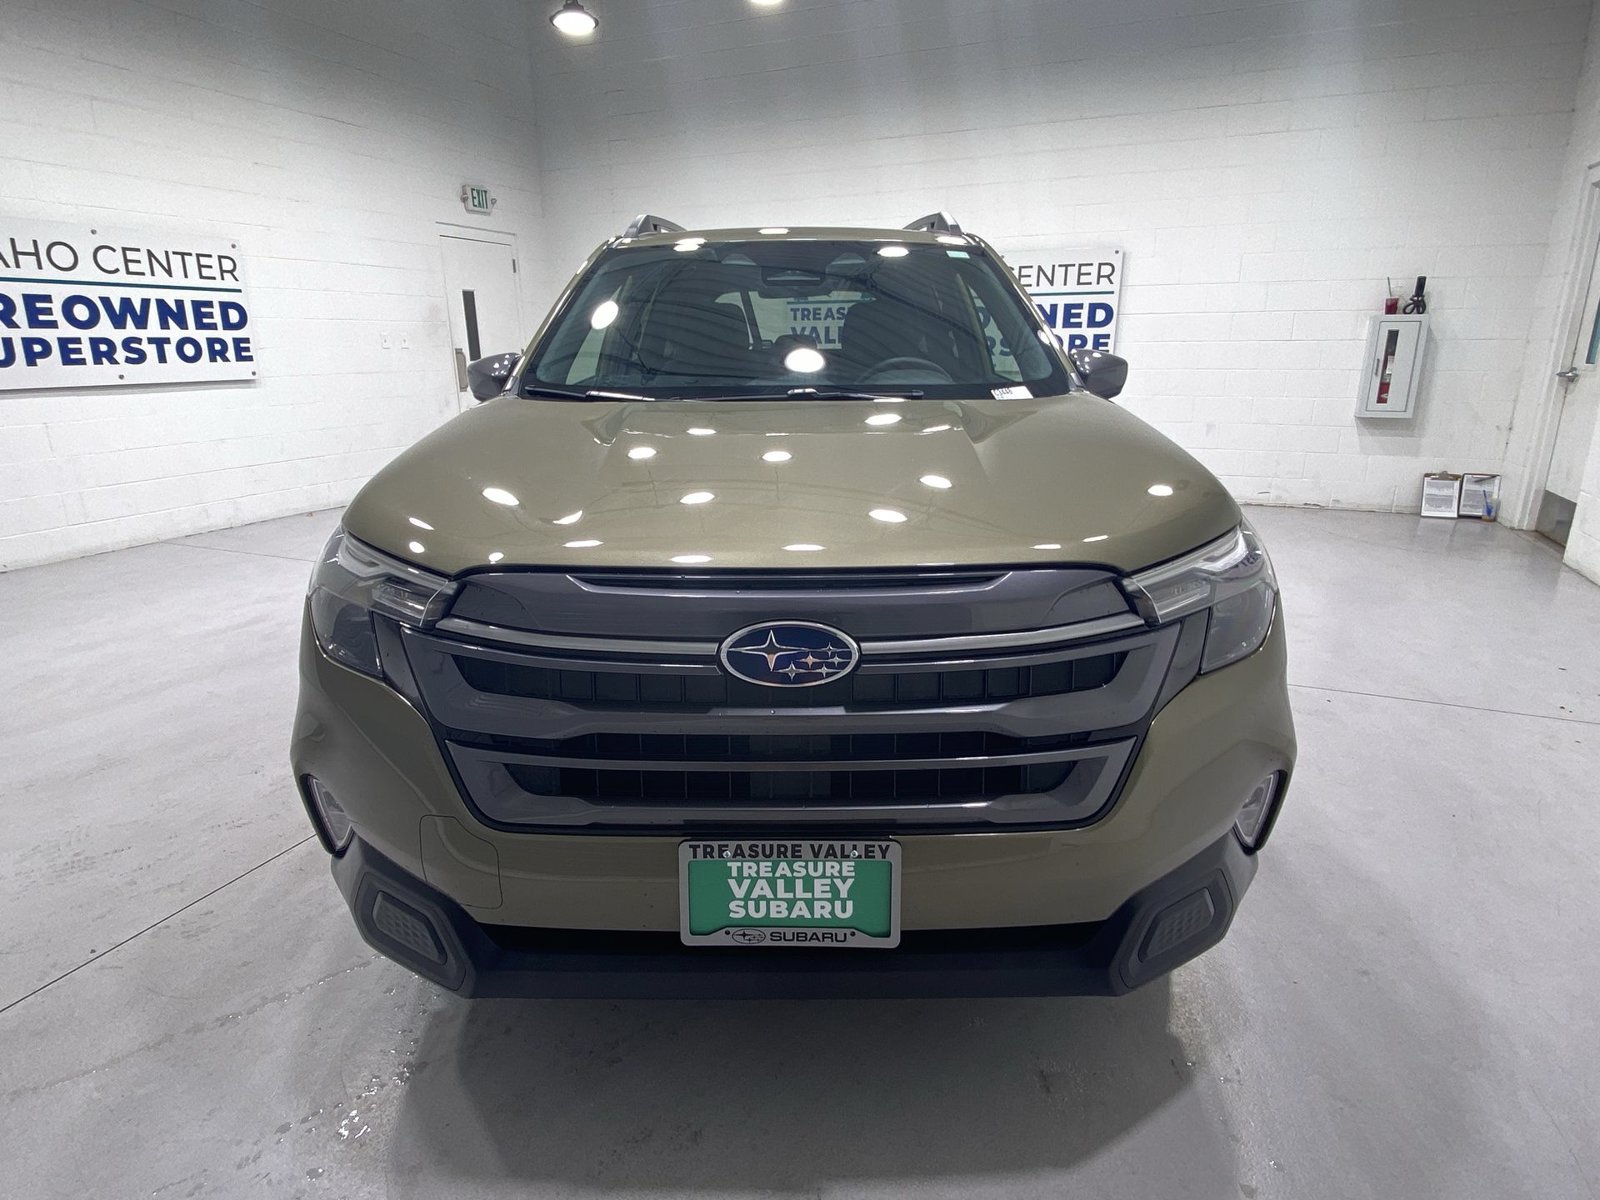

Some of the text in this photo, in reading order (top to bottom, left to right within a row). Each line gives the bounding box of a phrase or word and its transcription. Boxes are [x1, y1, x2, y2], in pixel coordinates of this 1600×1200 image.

[471, 187, 488, 209] EXIT
[92, 244, 239, 282] CENTER
[1008, 262, 1116, 288] ENTER
[689, 843, 891, 859] TREASURE VALLEY
[727, 861, 855, 877] TREASURE
[727, 878, 855, 899] VALLEY
[728, 900, 854, 919] SUBARU
[769, 931, 847, 943] SUBARU
